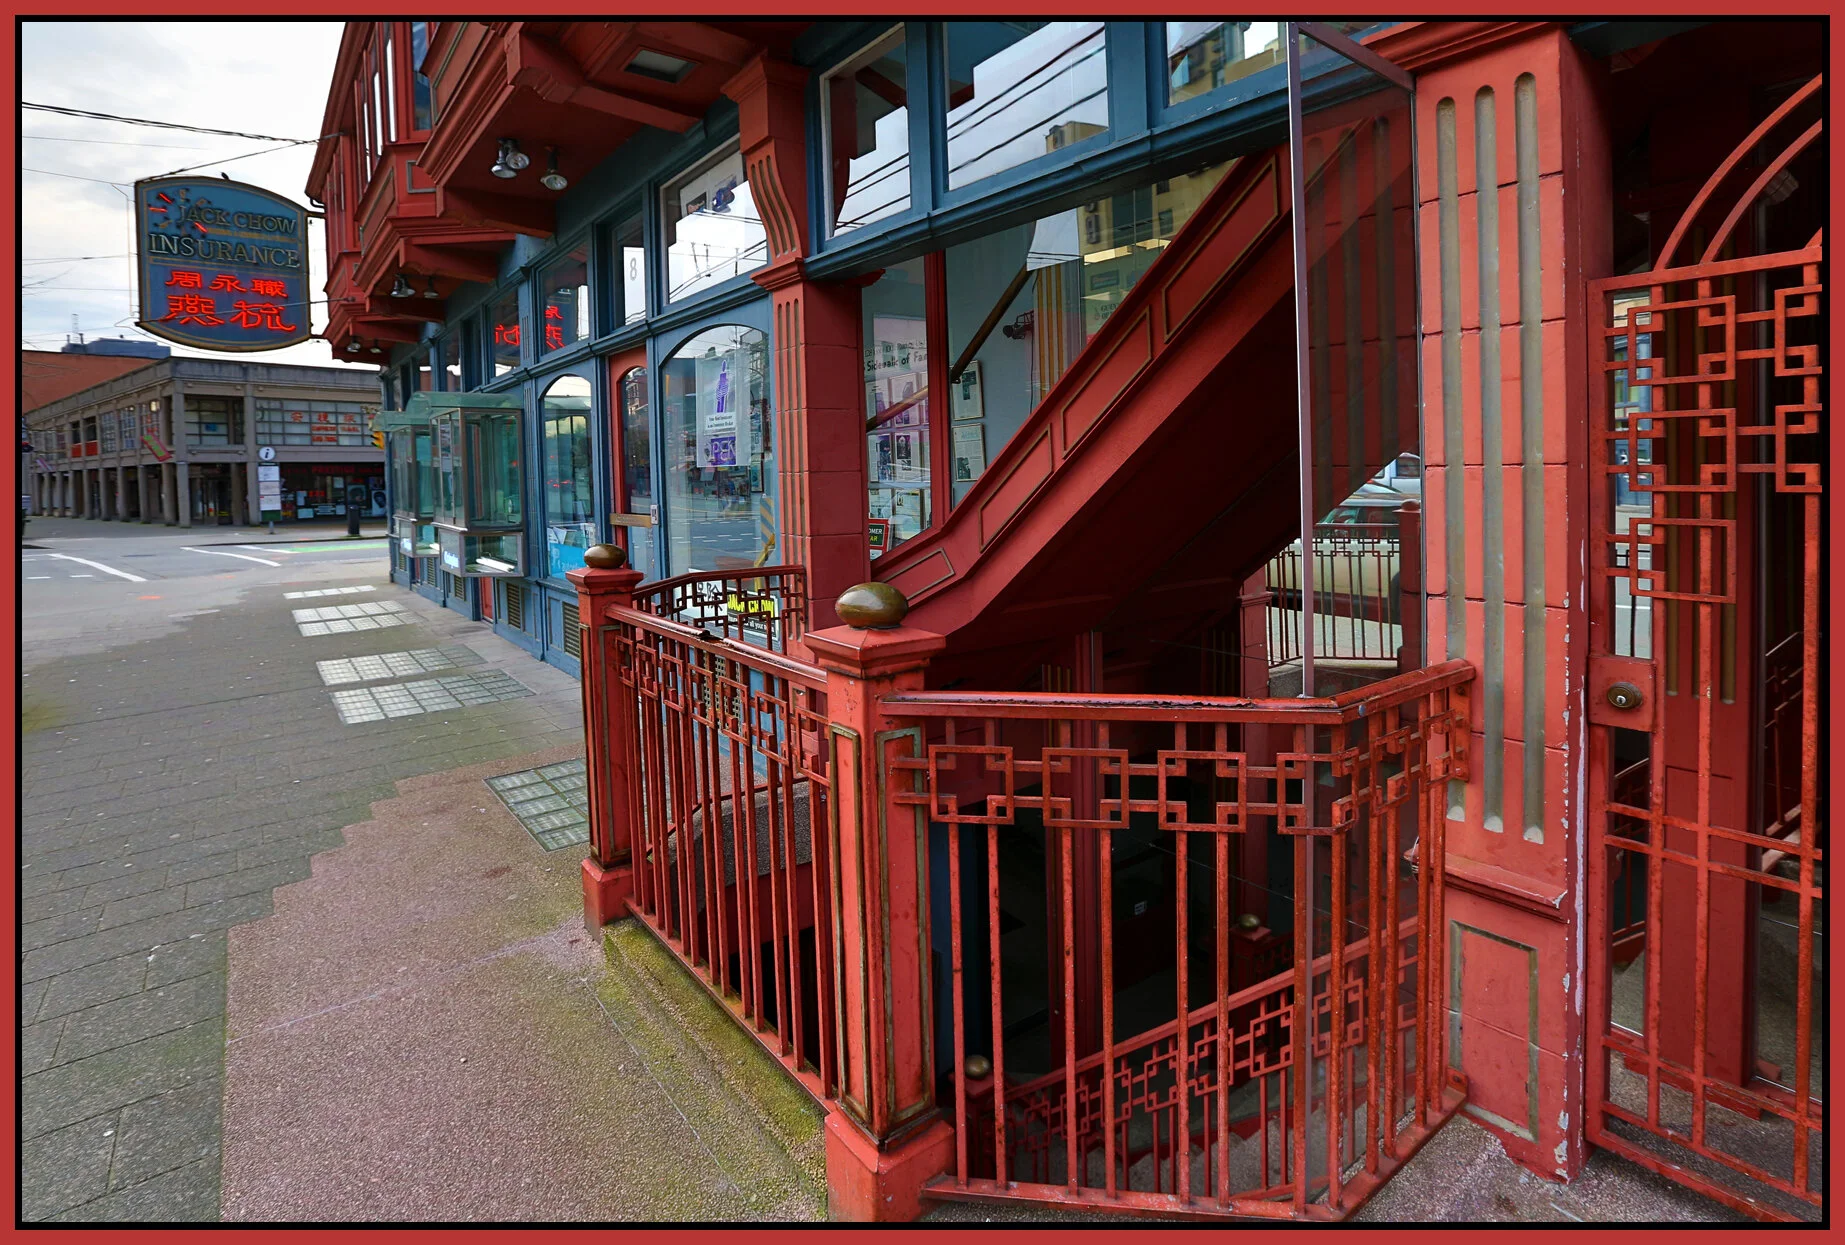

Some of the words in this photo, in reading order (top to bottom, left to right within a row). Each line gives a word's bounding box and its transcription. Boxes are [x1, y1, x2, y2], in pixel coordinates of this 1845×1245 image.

[177, 205, 231, 226] JACK
[233, 211, 297, 234] CHOW
[149, 232, 301, 268] INSURANCE
[630, 257, 637, 281] 8
[867, 355, 899, 371] Sidewalk
[901, 352, 911, 365] of
